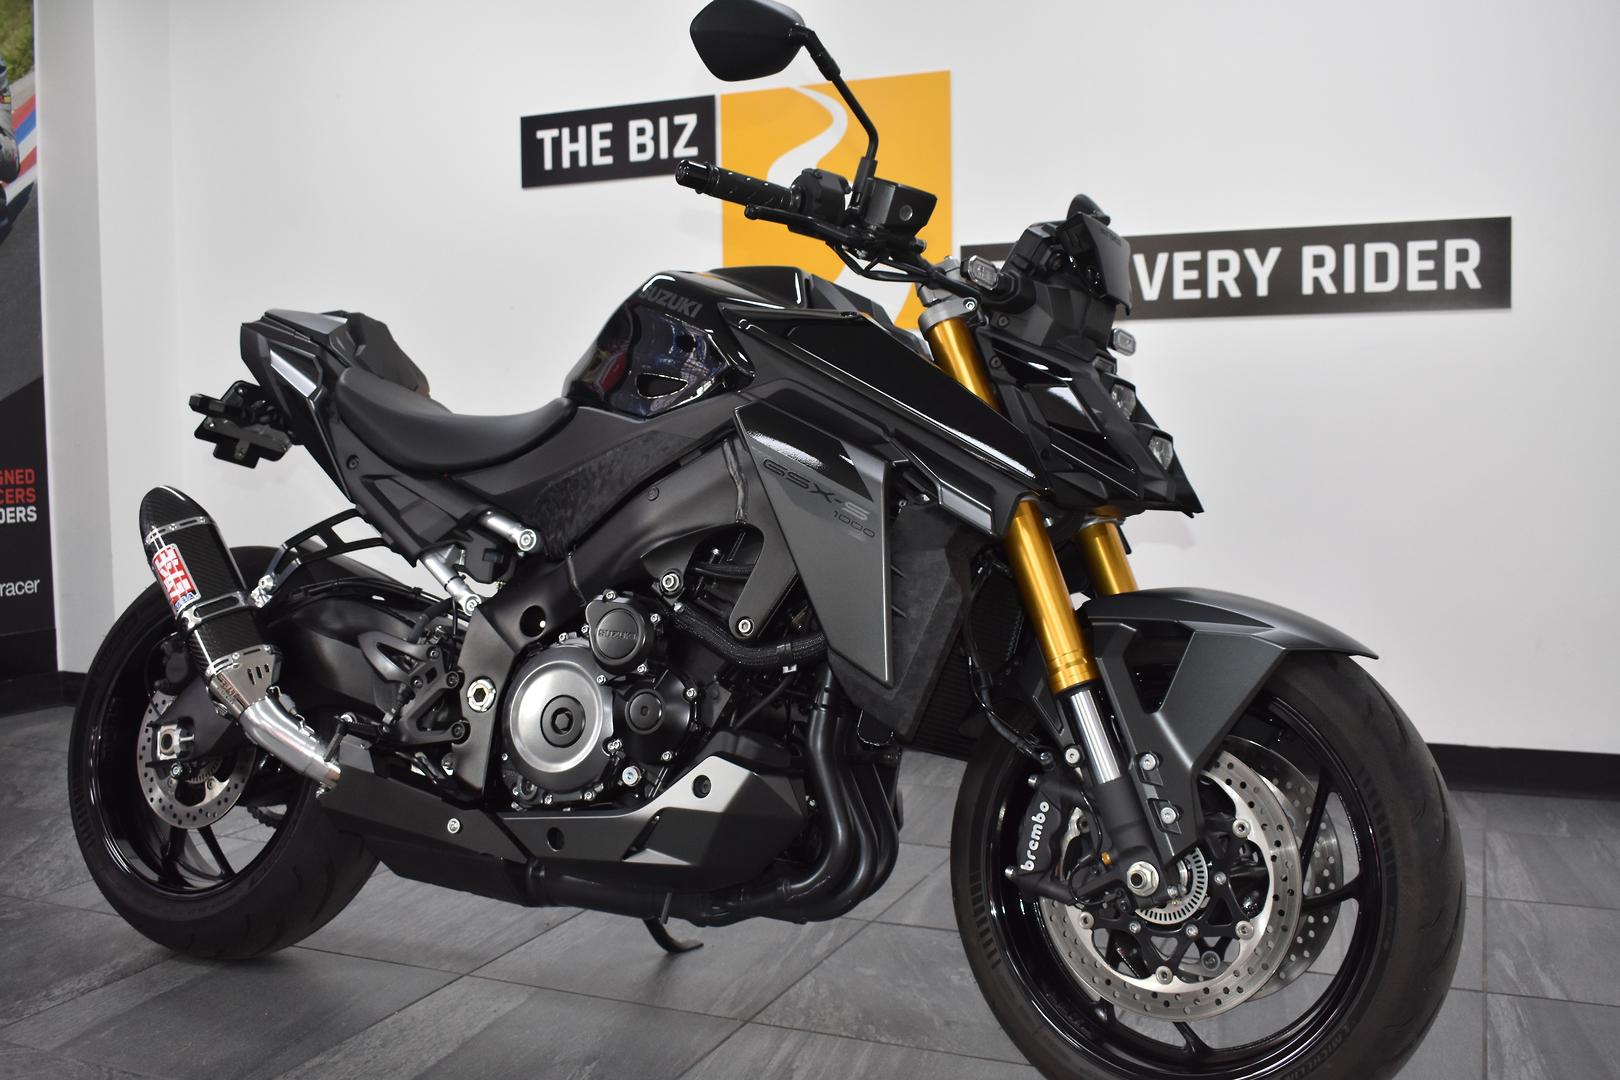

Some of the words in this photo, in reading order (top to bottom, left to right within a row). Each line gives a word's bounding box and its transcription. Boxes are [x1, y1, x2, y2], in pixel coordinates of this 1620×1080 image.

[535, 122, 614, 171] THE
[628, 113, 699, 163] BIZ
[1132, 246, 1282, 302] VERY
[1301, 239, 1482, 296] RIDER
[833, 510, 876, 538] 1000
[0, 579, 41, 597] racer
[599, 628, 638, 641] SUZUKI
[1019, 801, 1051, 872] brembo
